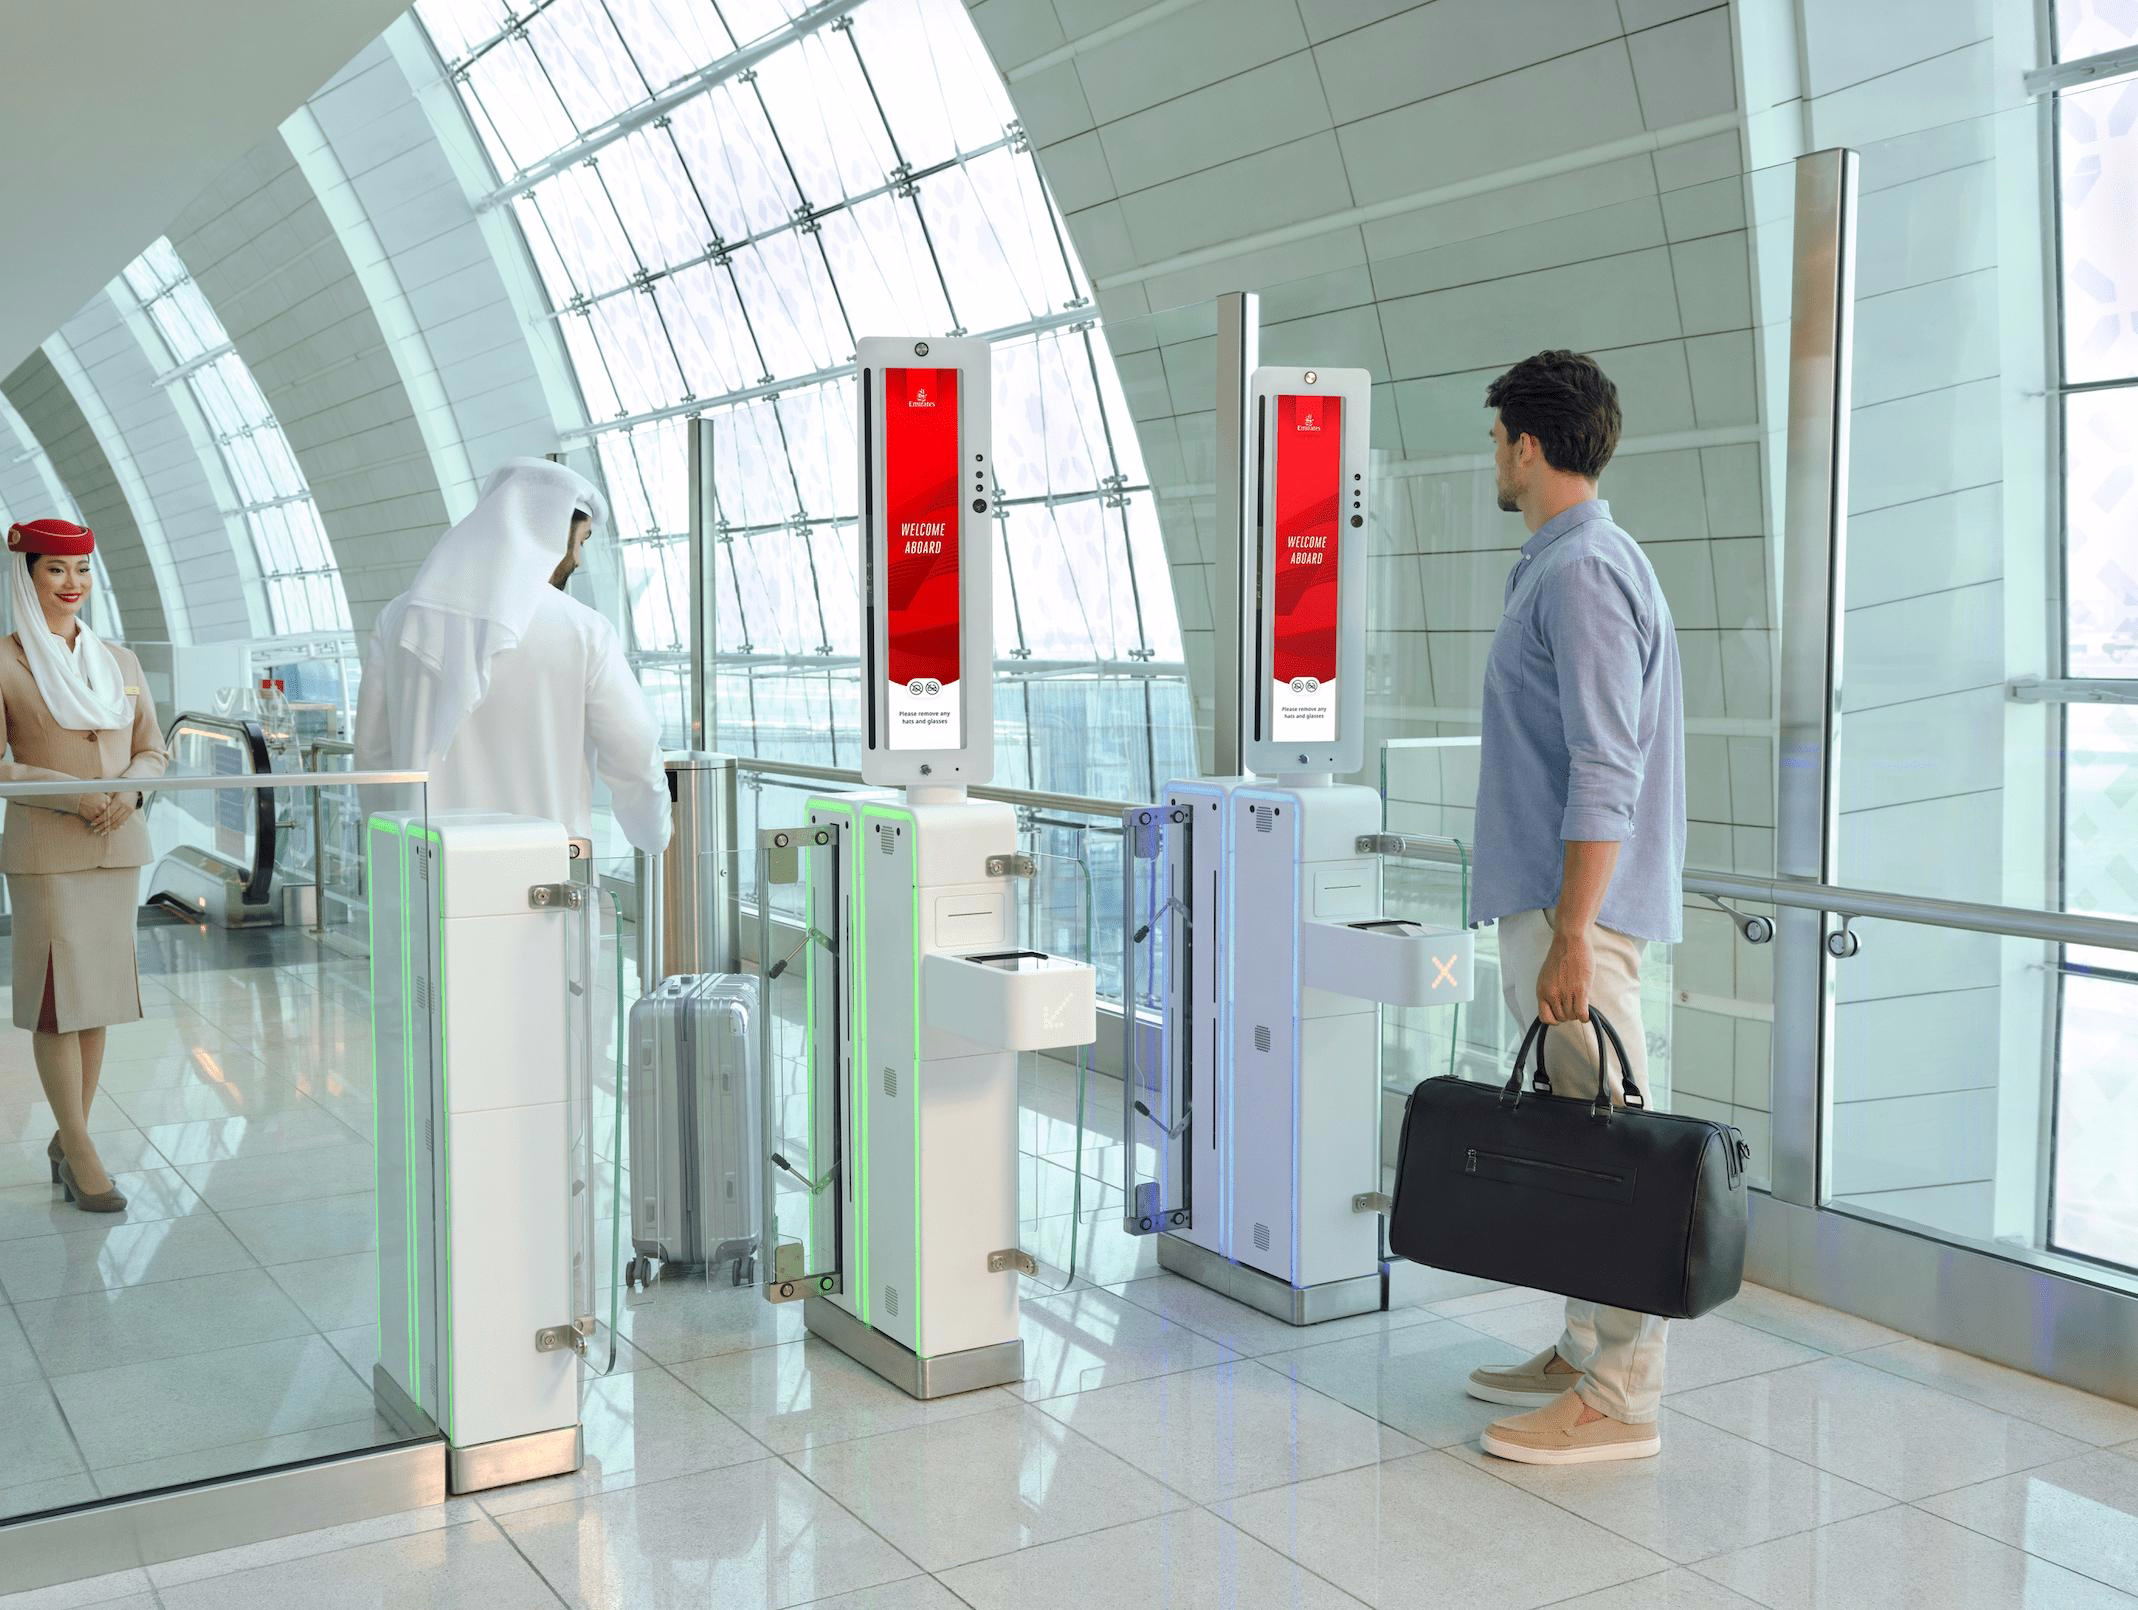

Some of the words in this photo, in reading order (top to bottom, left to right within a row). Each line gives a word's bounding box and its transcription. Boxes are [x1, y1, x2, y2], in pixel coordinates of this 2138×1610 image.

[901, 523, 946, 536] WELCOME
[904, 541, 942, 554] ABOARD
[1287, 536, 1327, 548] WELCOME
[1290, 552, 1323, 564] ABOARD
